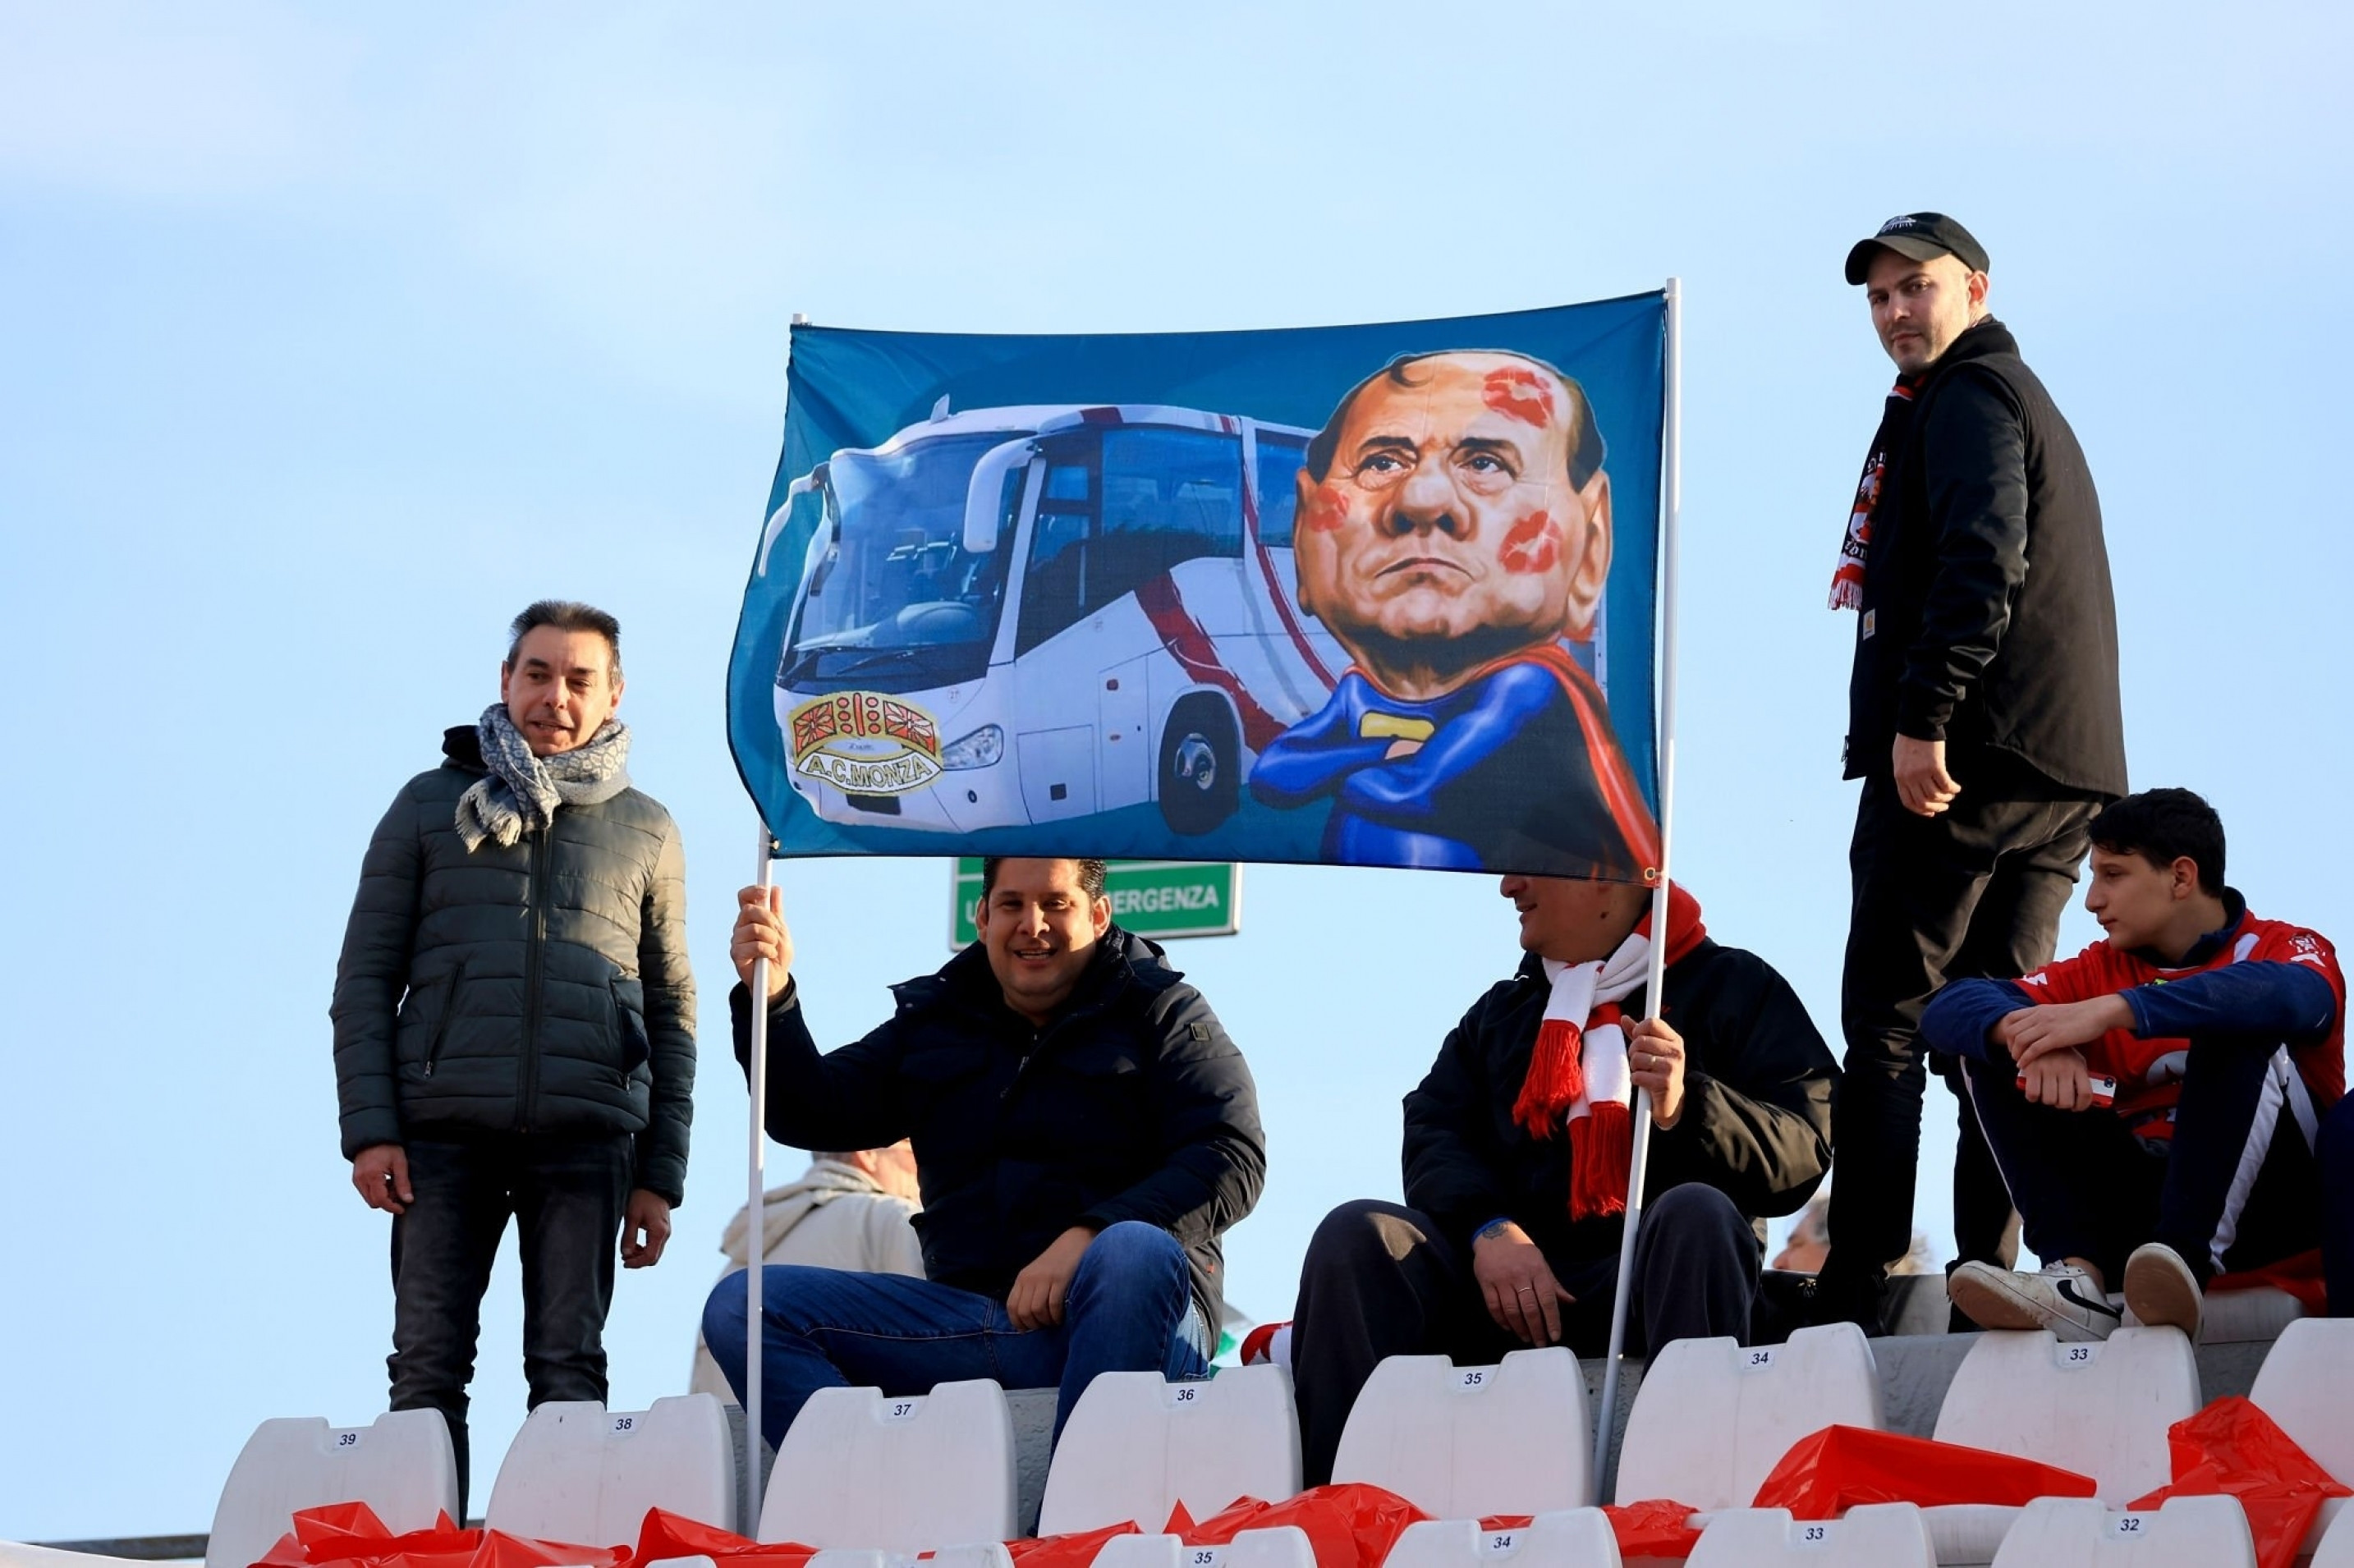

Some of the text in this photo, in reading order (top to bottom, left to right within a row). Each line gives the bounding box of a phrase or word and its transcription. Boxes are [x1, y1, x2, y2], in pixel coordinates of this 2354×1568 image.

[1108, 884, 1219, 915] ERGENZA
[1751, 1352, 1769, 1364] 34
[2070, 1349, 2088, 1361] 33
[1465, 1373, 1482, 1385] 35
[1177, 1389, 1195, 1401] 36
[894, 1404, 912, 1416] 37
[615, 1418, 633, 1431] 38
[339, 1433, 356, 1446] 39
[2120, 1518, 2140, 1532] 32
[1806, 1527, 1824, 1540] 33
[1494, 1536, 1511, 1549] 34
[1195, 1552, 1213, 1564] 35
